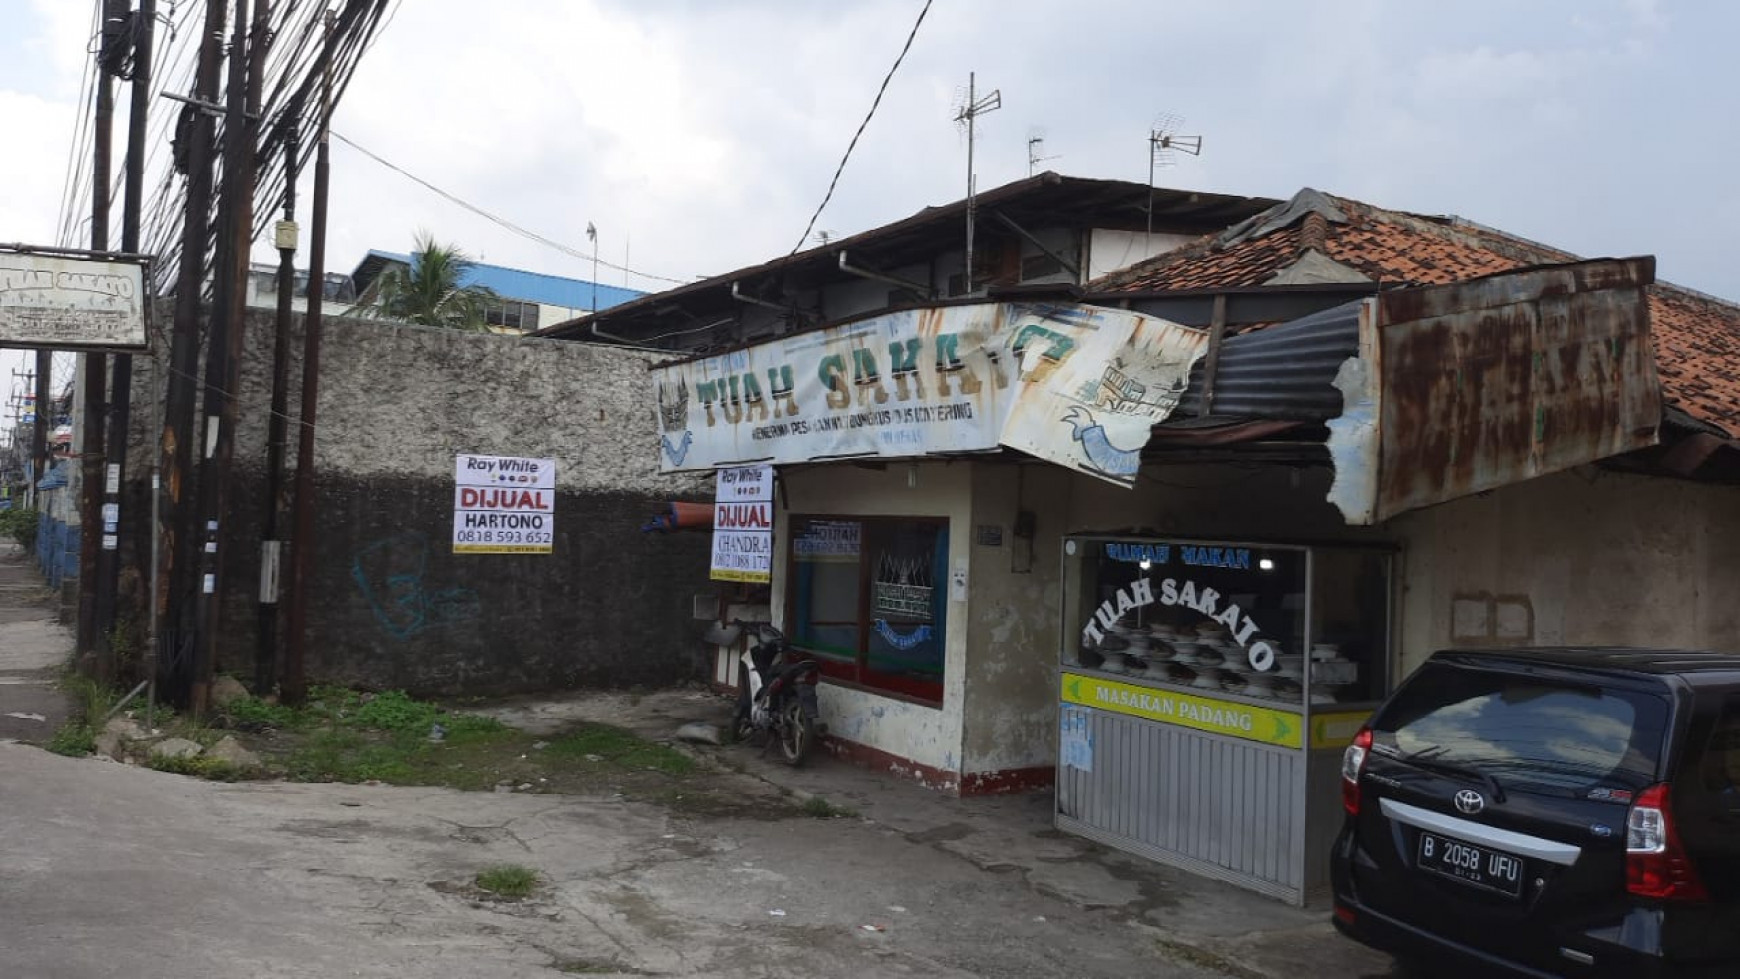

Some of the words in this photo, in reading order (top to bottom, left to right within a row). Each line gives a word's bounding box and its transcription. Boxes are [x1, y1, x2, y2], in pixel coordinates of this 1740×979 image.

[696, 364, 799, 427] TUAH
[467, 457, 496, 472] Ray
[499, 459, 539, 472] White
[722, 469, 739, 484] Ray
[739, 468, 763, 483] White
[461, 488, 549, 511] DIJUAL
[465, 513, 543, 529] HARTONO
[718, 505, 771, 528] DIJUAL
[457, 530, 493, 542] 0818
[497, 531, 522, 543] 593
[526, 532, 551, 544] 652
[718, 535, 770, 553] CHANDRA
[1082, 577, 1154, 647] TUAH
[1161, 578, 1275, 672] SAKATO
[1095, 686, 1174, 716] MASAKAN
[1178, 701, 1252, 731] PADANG
[1424, 836, 1434, 857] B
[1443, 842, 1480, 870] 2058
[1489, 854, 1518, 881] UFU
